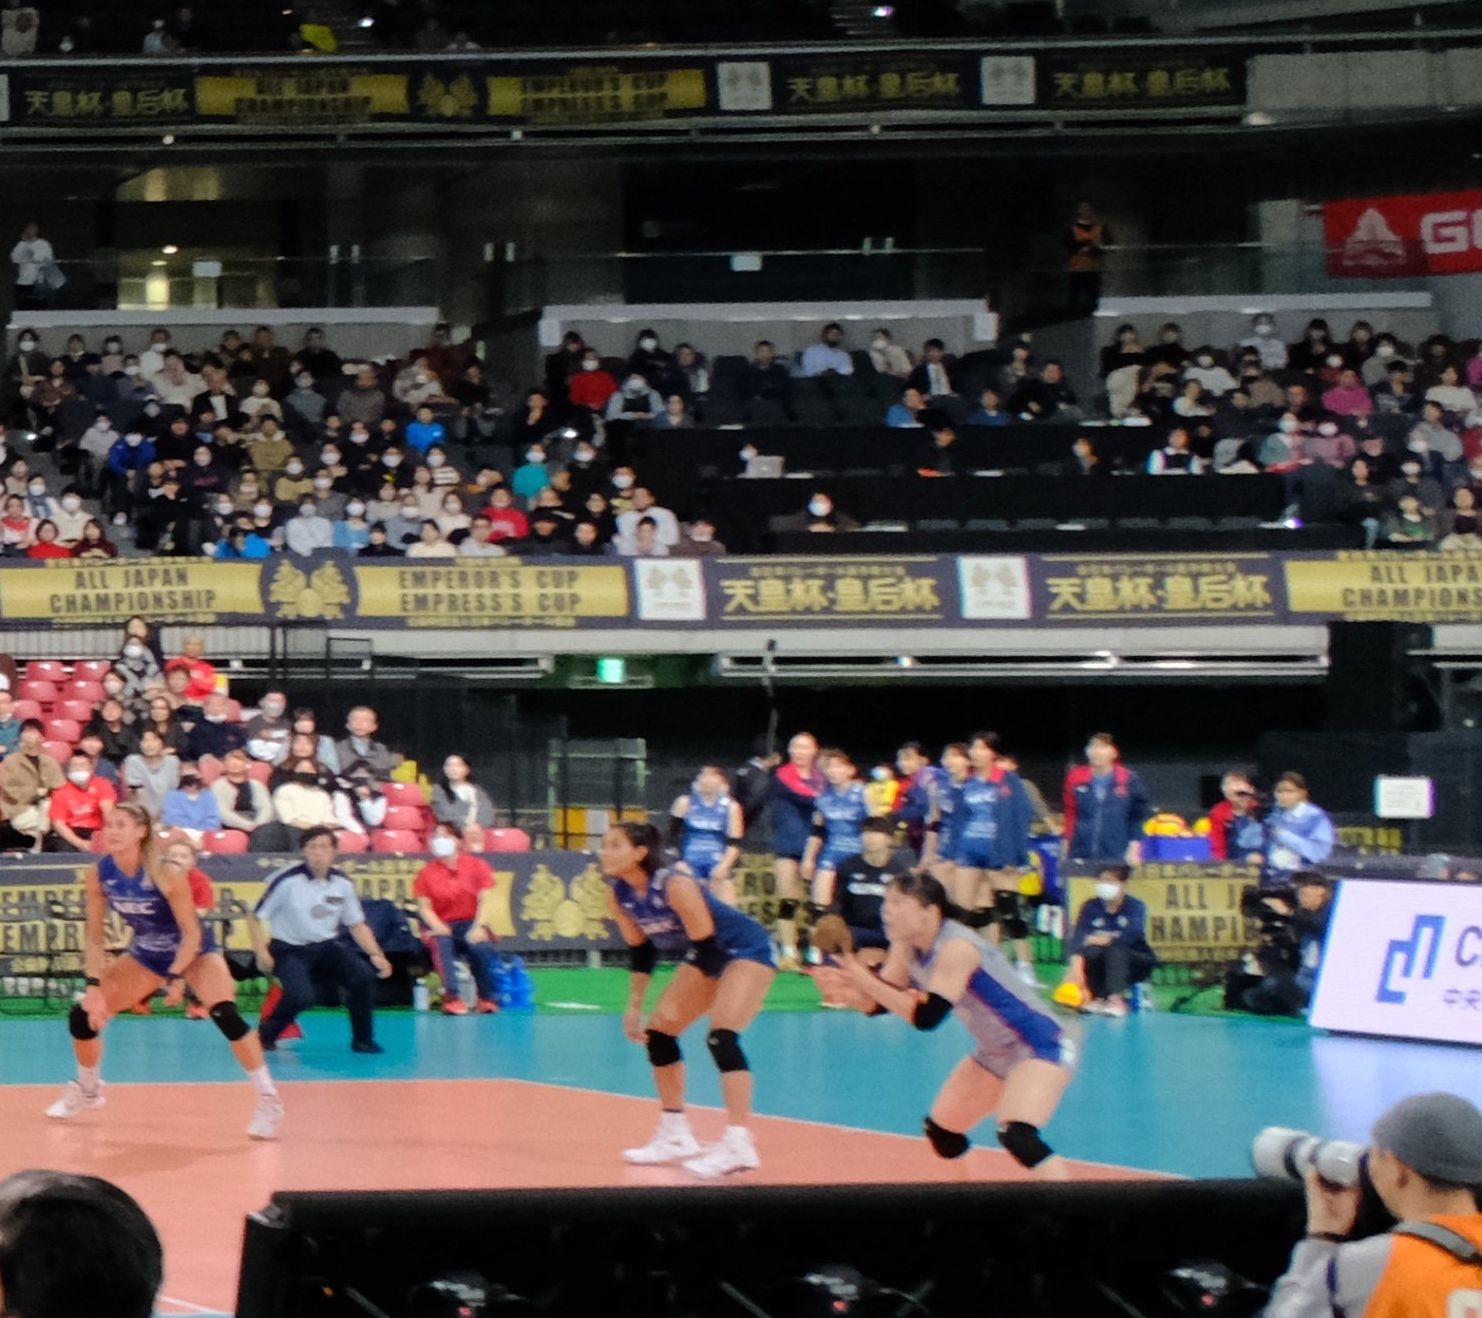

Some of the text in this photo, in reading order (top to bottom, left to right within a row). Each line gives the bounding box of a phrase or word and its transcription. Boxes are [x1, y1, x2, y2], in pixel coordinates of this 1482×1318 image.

[75, 567, 189, 590] ALL JAPAN
[399, 570, 580, 589] EMPEROR'S CUP
[1370, 565, 1408, 584] ALL
[50, 590, 216, 615] CHAMPIONSHIP
[401, 593, 581, 613] EMPRESS'S CUP
[1165, 883, 1208, 909] ALL
